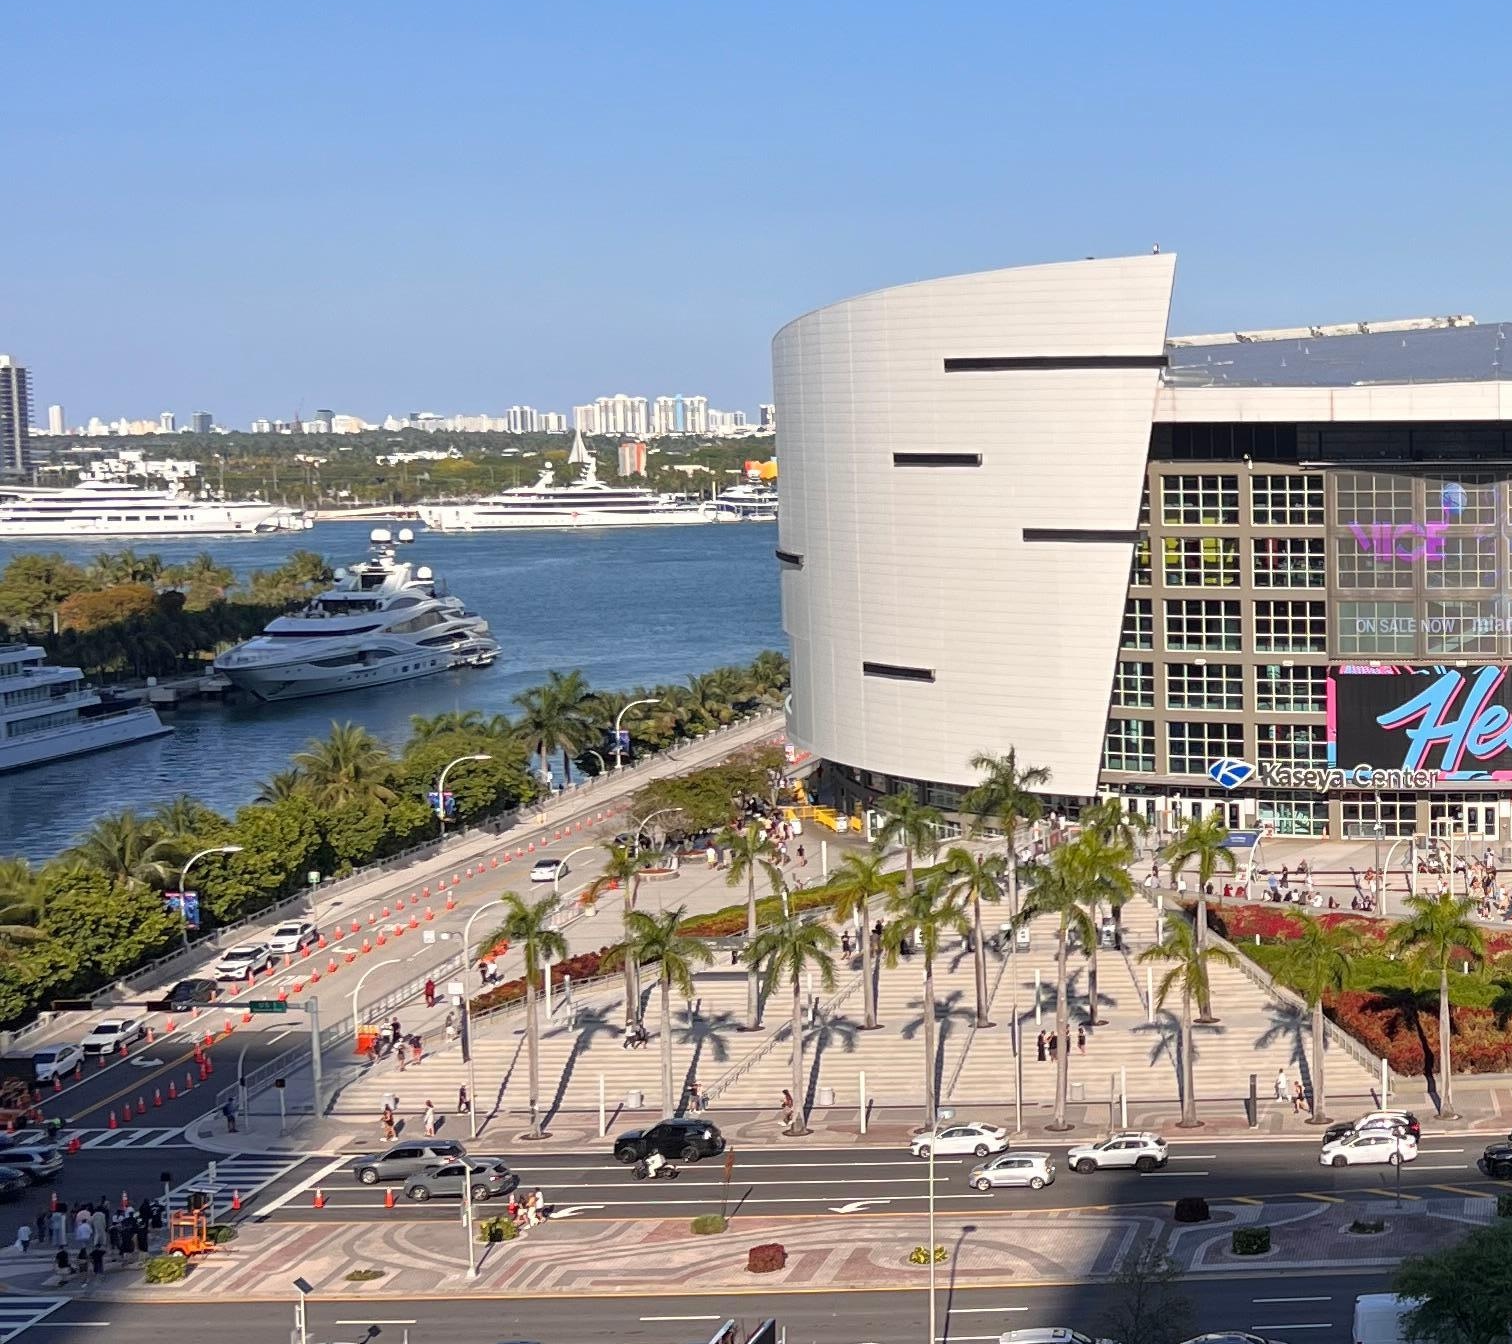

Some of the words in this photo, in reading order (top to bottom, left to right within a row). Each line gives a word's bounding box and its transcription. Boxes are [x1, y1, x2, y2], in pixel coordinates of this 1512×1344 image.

[1356, 618, 1376, 633] ON
[1379, 617, 1417, 633] SALE
[1421, 618, 1455, 633] NOW
[1261, 762, 1346, 793] Kaseya
[1353, 763, 1440, 789] Center
